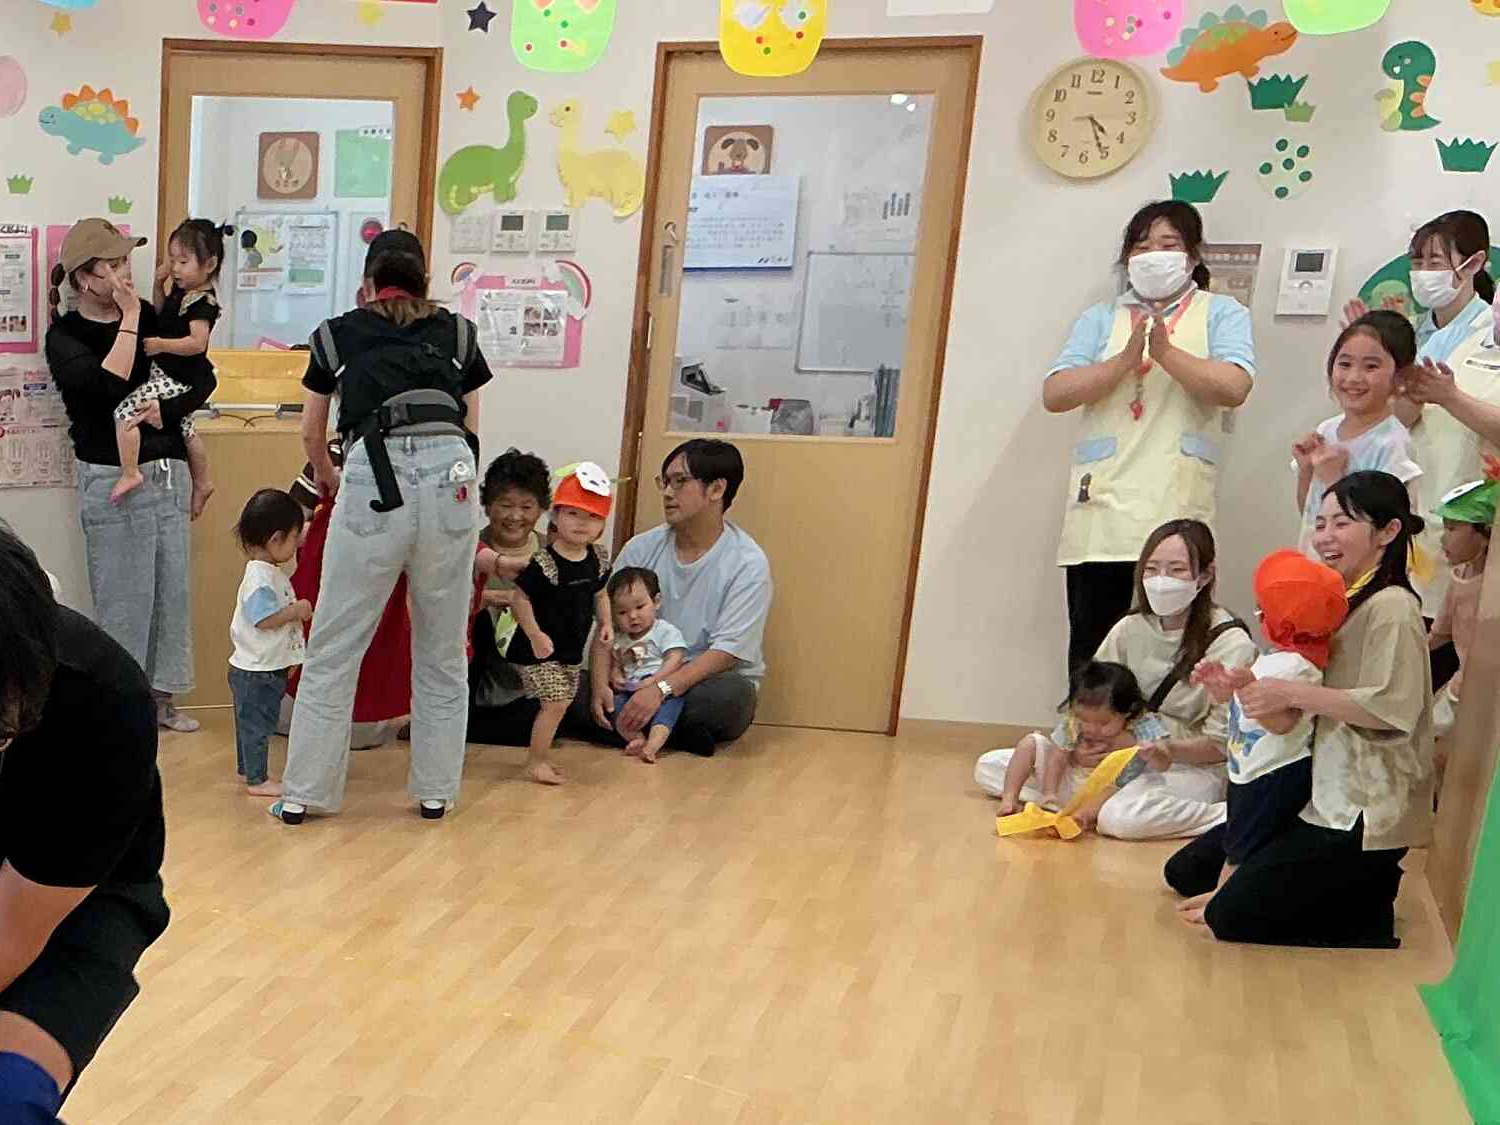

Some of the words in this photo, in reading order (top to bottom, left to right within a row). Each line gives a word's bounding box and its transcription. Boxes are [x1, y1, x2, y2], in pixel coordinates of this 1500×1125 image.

[1071, 74, 1082, 88] 11
[1091, 69, 1105, 83] 12
[1114, 75, 1120, 89] 1
[1053, 88, 1067, 102] 10
[1124, 90, 1135, 104] 2
[1045, 108, 1056, 122] 9
[1125, 111, 1137, 125] 3
[1047, 128, 1058, 143] 8
[1116, 131, 1125, 144] 4
[1060, 144, 1070, 158] 7
[1078, 150, 1089, 164] 6
